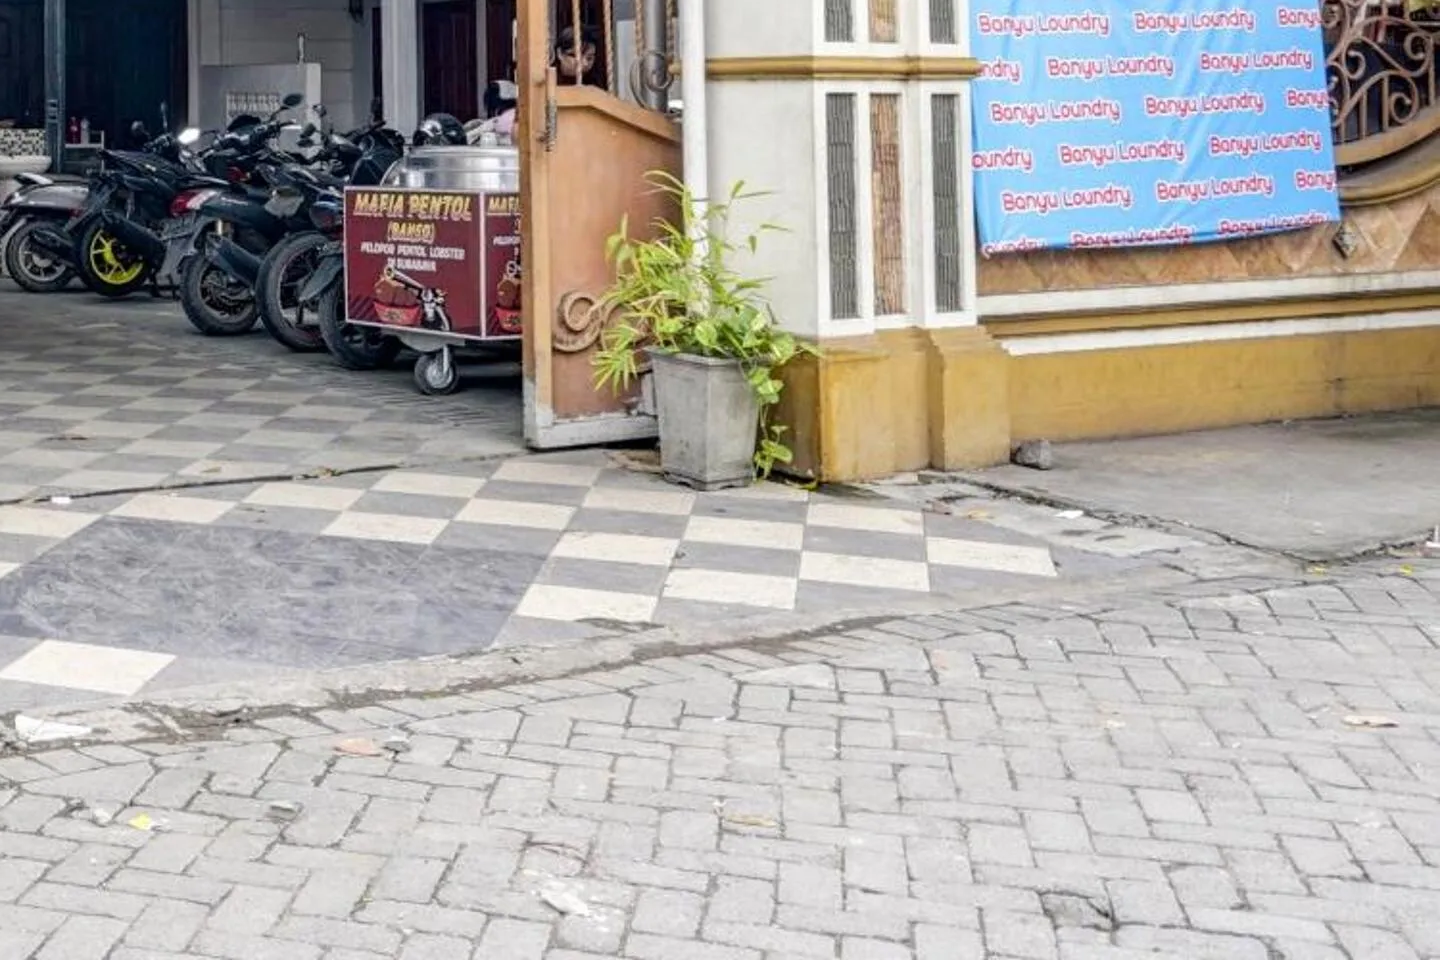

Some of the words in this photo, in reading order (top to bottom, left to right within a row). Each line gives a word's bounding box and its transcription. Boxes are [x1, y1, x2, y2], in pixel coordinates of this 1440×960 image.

[979, 14, 1034, 36] Banyu
[1038, 12, 1109, 35] Laundry
[1135, 12, 1187, 33] Banyu
[1191, 9, 1254, 29] Laundry
[1048, 58, 1103, 80] Banyu
[1107, 55, 1173, 76] Laundry
[1200, 53, 1249, 73] Banyu
[1253, 50, 1312, 70] Laundry
[991, 103, 1045, 124] Banyu
[1050, 99, 1120, 121] Laundry
[1145, 97, 1197, 117] Banyu
[1201, 93, 1264, 112] Laundry
[1060, 145, 1114, 166] Banyu
[1118, 141, 1184, 161] Laundry
[1210, 136, 1258, 155] Banyu
[1262, 131, 1321, 150] Laundry
[354, 193, 404, 215] MAFIA
[408, 194, 472, 220] PENTOL
[1002, 193, 1058, 213] Banyu
[1063, 187, 1131, 206] Laundry
[1156, 182, 1207, 200] Banyu
[1212, 175, 1273, 194] Laundry
